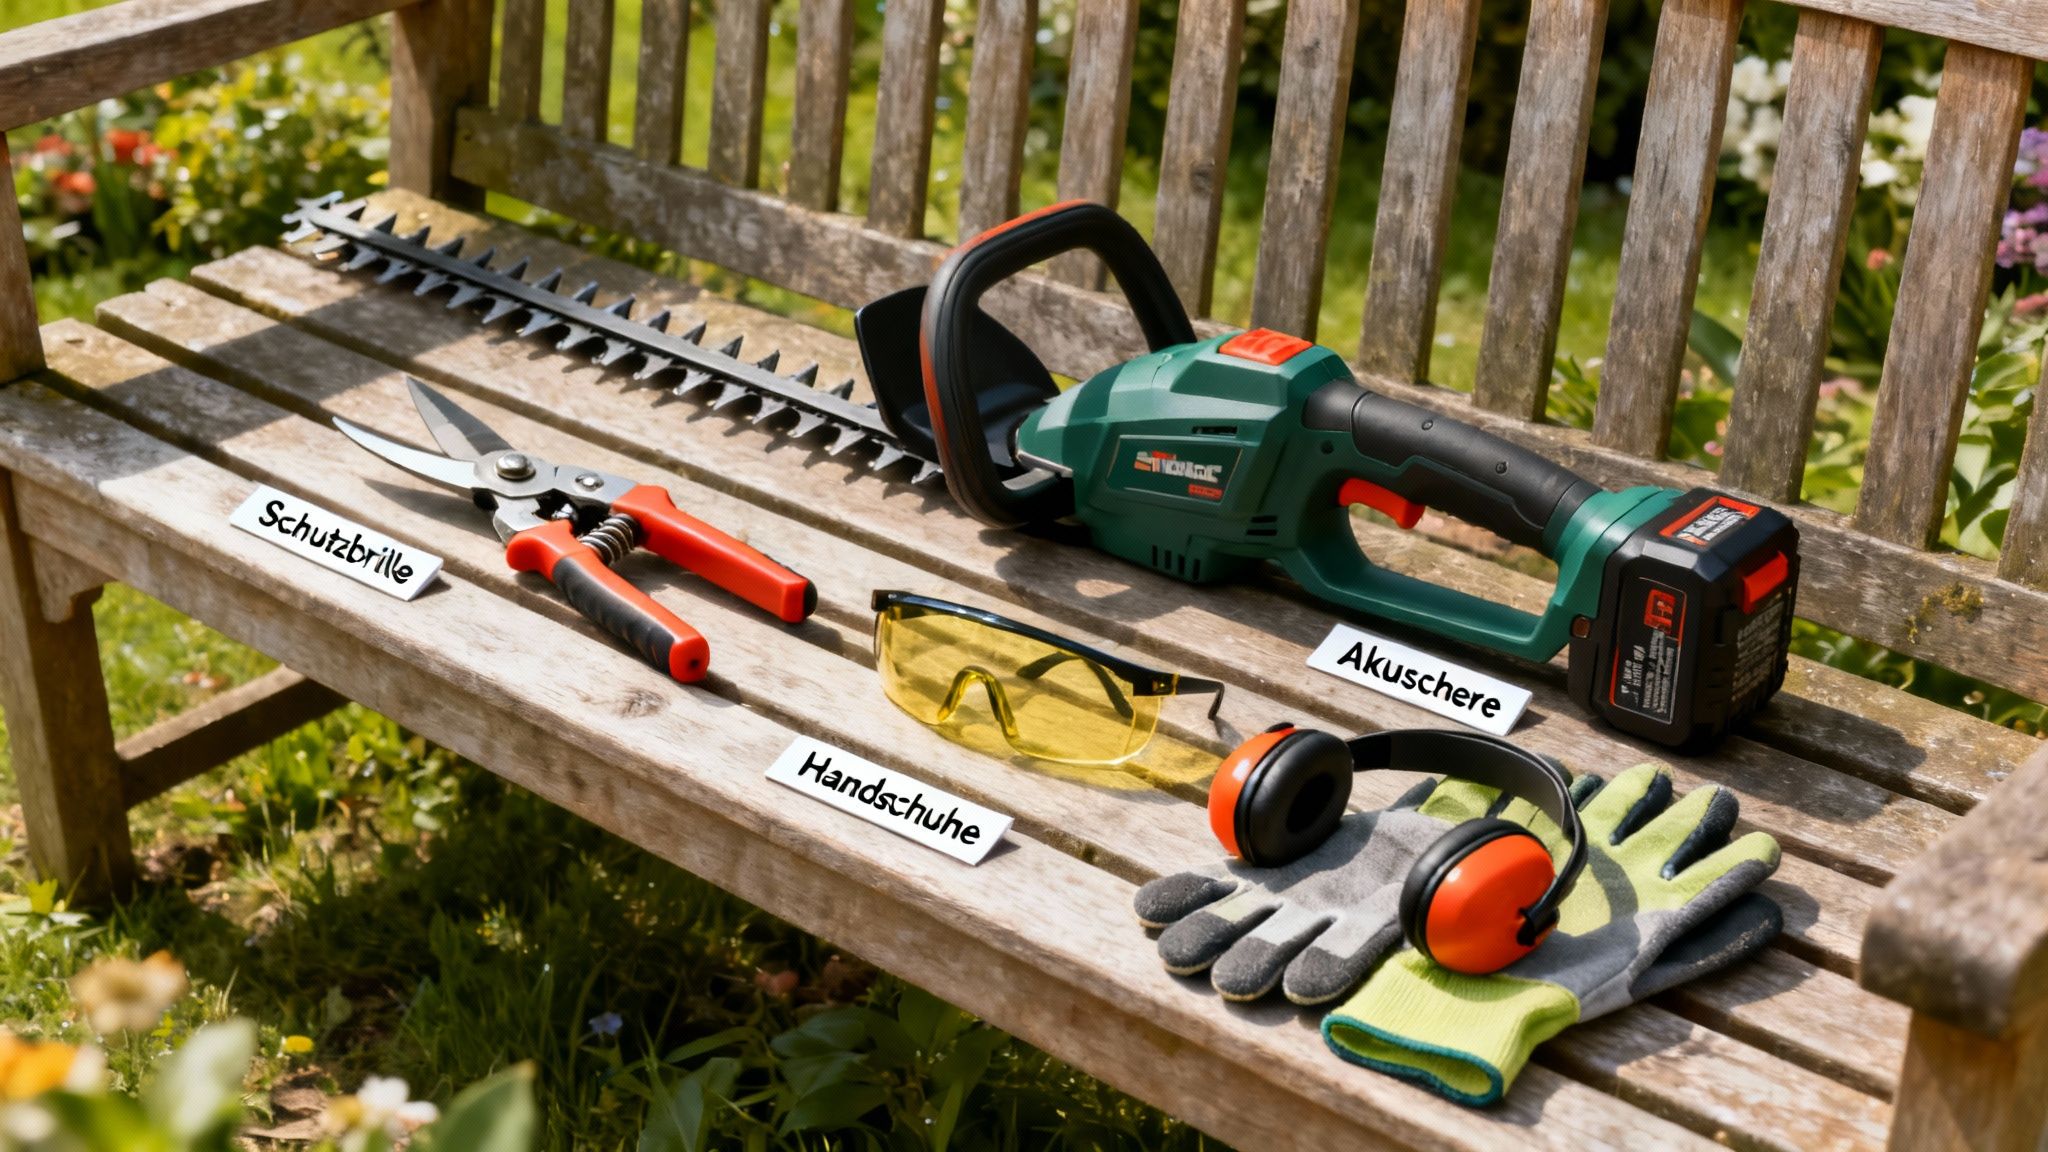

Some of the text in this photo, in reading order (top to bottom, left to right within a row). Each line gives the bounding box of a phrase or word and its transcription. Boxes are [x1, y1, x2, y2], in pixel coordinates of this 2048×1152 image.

[259, 500, 413, 584] Schutzbrille
[1337, 641, 1501, 718] Akuschere
[798, 751, 981, 845] Handschuhe
